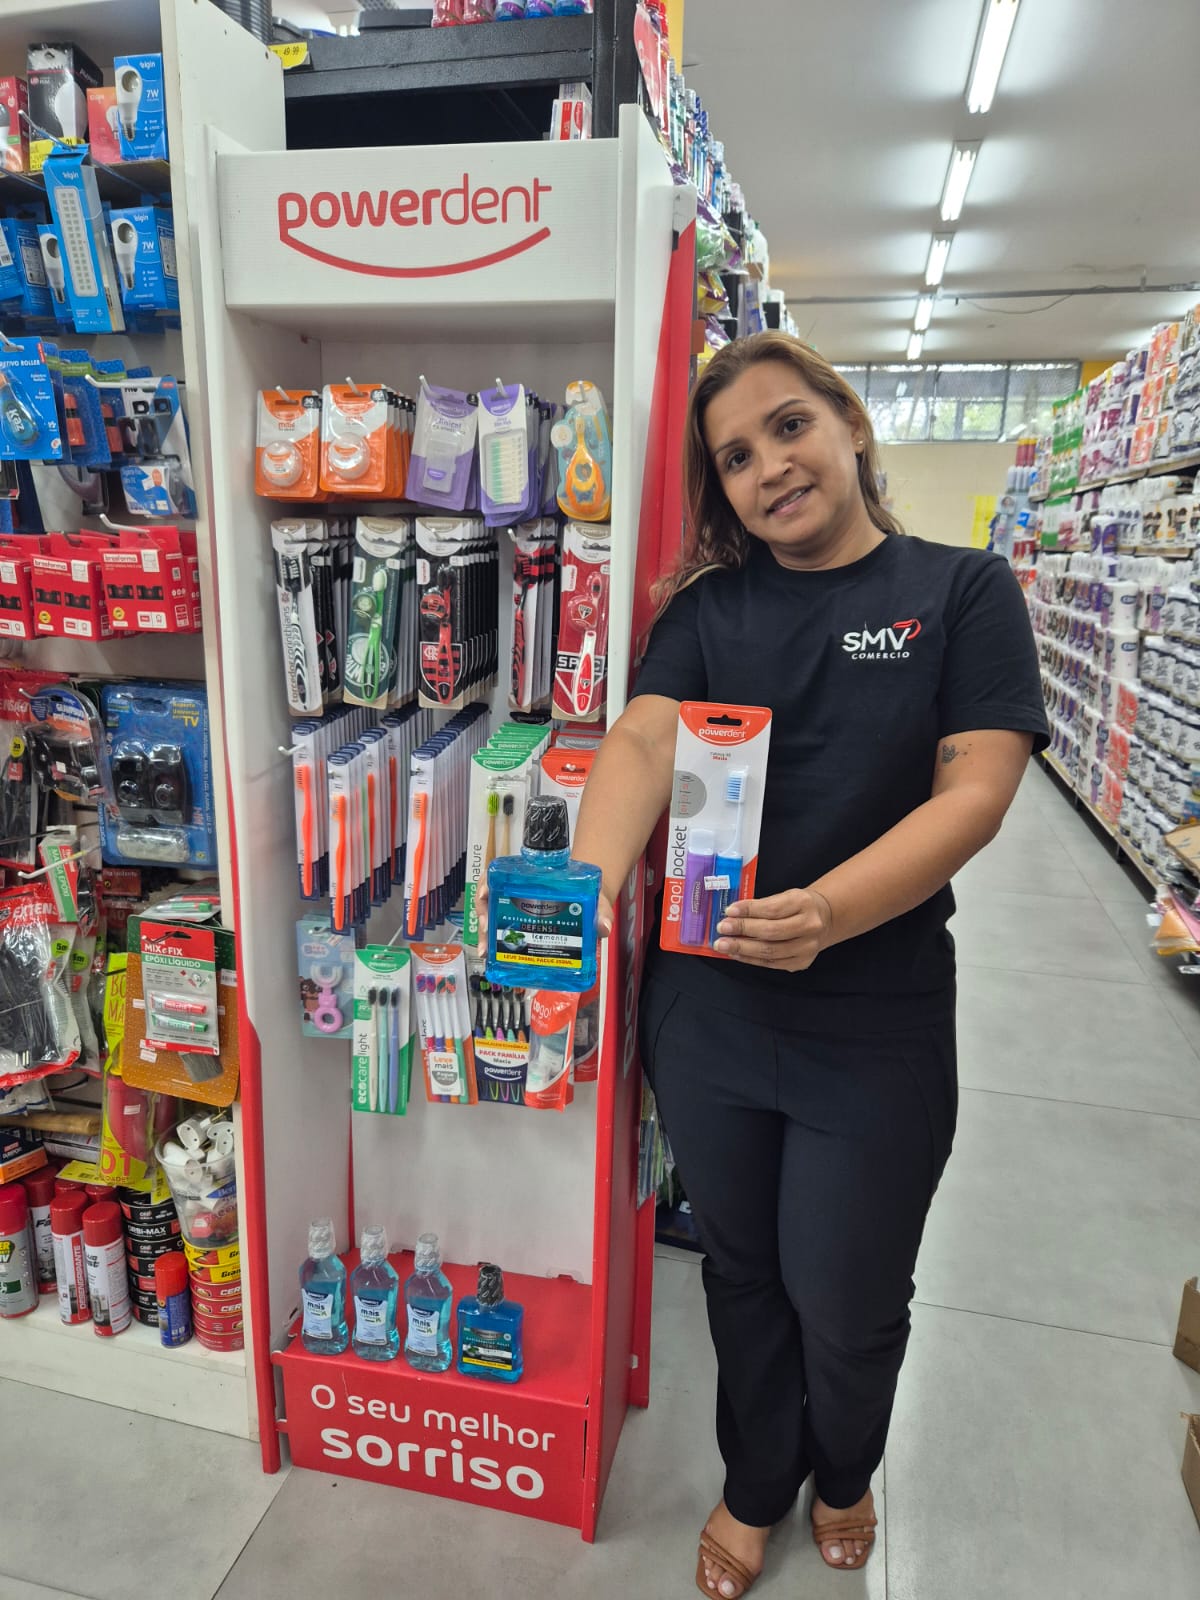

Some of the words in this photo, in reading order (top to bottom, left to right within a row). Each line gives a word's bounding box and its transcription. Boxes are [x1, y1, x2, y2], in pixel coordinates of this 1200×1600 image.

[146, 89, 159, 98] 7W
[62, 171, 79, 180] elgin
[278, 172, 552, 240] powerdent
[133, 214, 149, 222] elgin
[842, 627, 911, 652] SMV
[851, 651, 910, 660] COMERCIO
[184, 716, 199, 727] TV
[699, 728, 746, 738] powerdent
[672, 825, 687, 877] pocket
[472, 844, 482, 882] nature
[521, 924, 557, 933] DEFENSE
[144, 943, 161, 953] MIX
[168, 947, 183, 956] FIX
[145, 955, 169, 964] EPÓXI
[169, 957, 201, 968] LÍQUIDO
[358, 1034, 369, 1056] light
[358, 1056, 368, 1104] ecocare
[307, 1301, 325, 1310] mais
[360, 1308, 380, 1317] mais
[412, 1317, 431, 1327] mais
[311, 1384, 336, 1410] O
[347, 1394, 411, 1423] seu
[424, 1409, 556, 1452] melhor
[320, 1427, 545, 1500] sorriso
